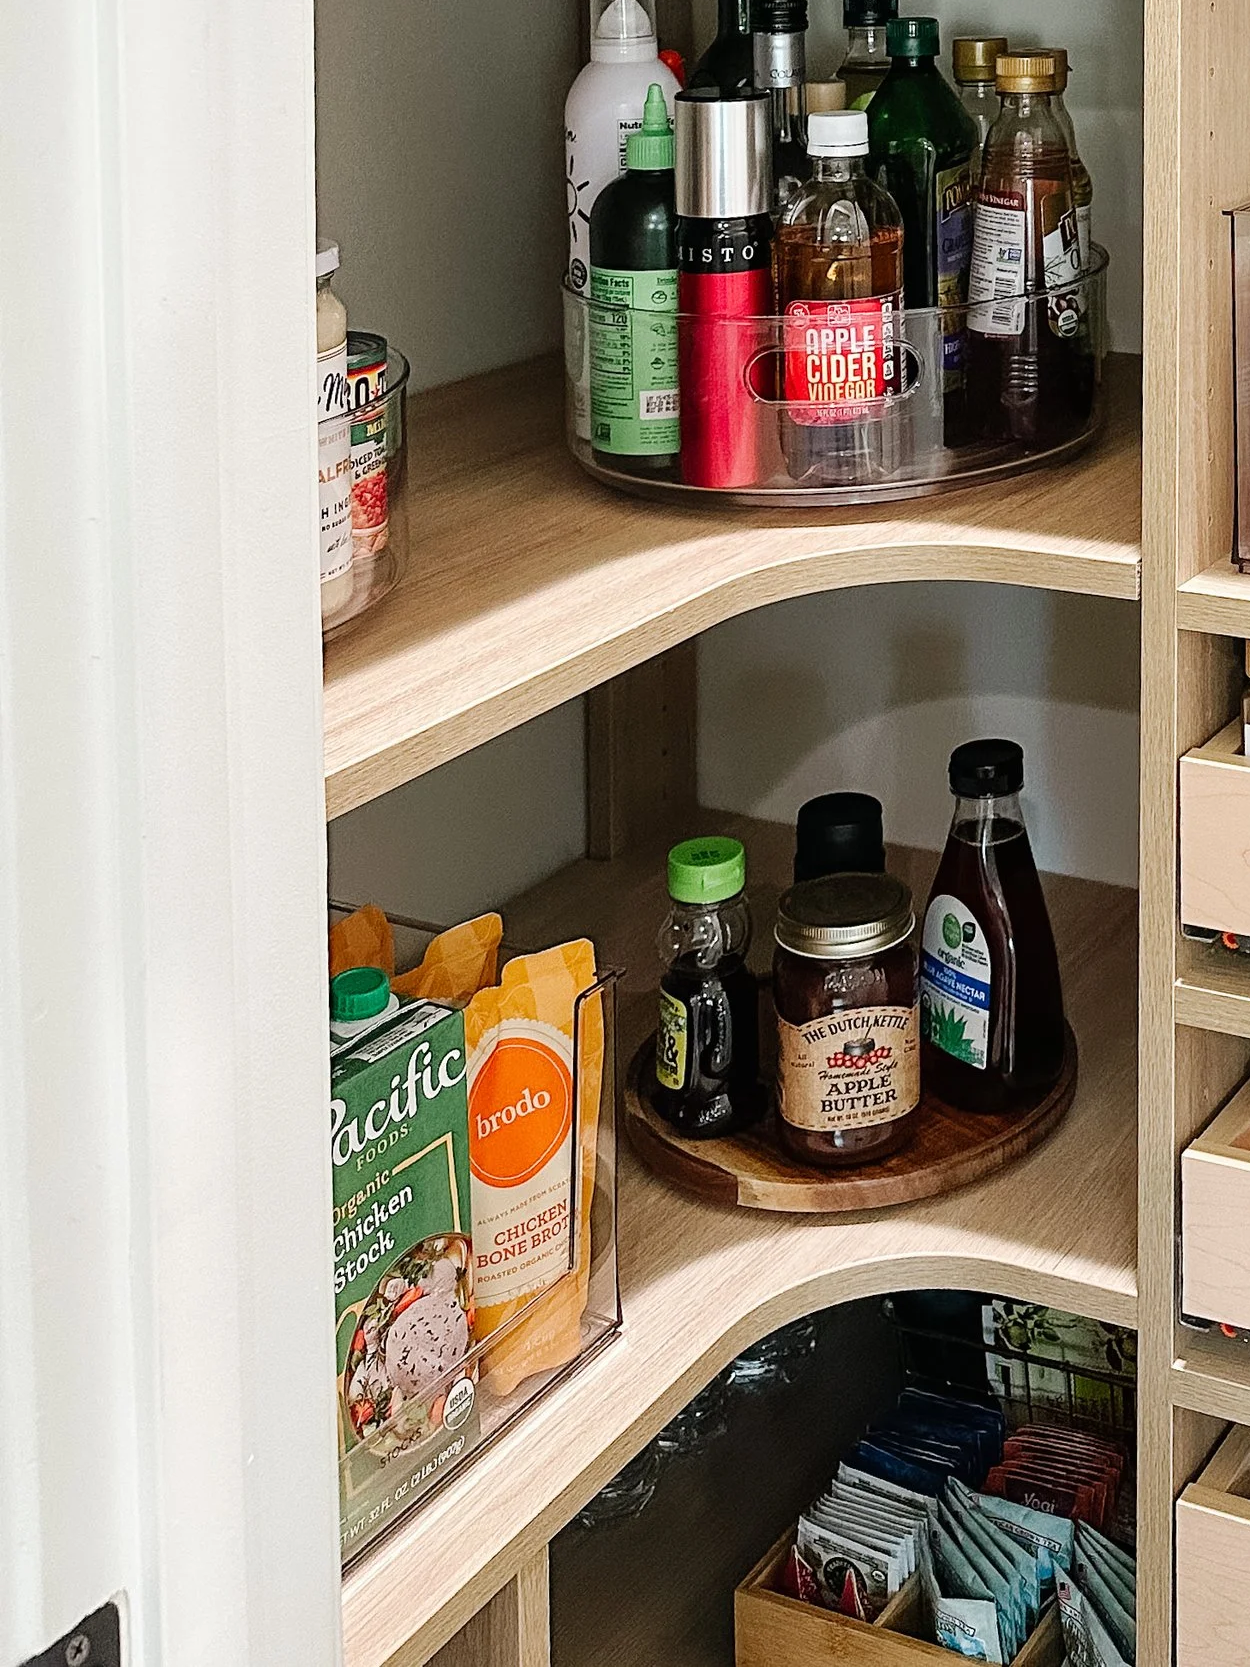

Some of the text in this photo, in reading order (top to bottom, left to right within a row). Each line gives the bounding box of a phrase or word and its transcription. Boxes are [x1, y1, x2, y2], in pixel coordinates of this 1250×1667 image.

[611, 313, 628, 324] 120
[805, 324, 876, 355] APPLE
[806, 351, 877, 384] CIDER
[807, 379, 877, 402] VINEGAR
[350, 451, 373, 470] DICED
[354, 469, 361, 479] &
[937, 946, 966, 970] organic
[956, 983, 985, 1002] NECTAR
[802, 1015, 910, 1045] THE DUTCH KETTLE
[818, 1066, 871, 1081] Homemade
[826, 1074, 892, 1097] APPLE
[331, 1042, 467, 1167] Pacific
[476, 1088, 551, 1140] brodo
[821, 1088, 898, 1113] BUTTER
[355, 1125, 408, 1172] FOODS
[477, 1210, 509, 1226] ALWAYS
[529, 1190, 547, 1203] FROM
[494, 1198, 568, 1246] CHICKEN
[333, 1186, 414, 1261] Chicken
[334, 1230, 395, 1292] Stock
[476, 1239, 528, 1269] BONE
[477, 1248, 554, 1284] ROASTED ORGANIC
[379, 1426, 422, 1469] STOCKS
